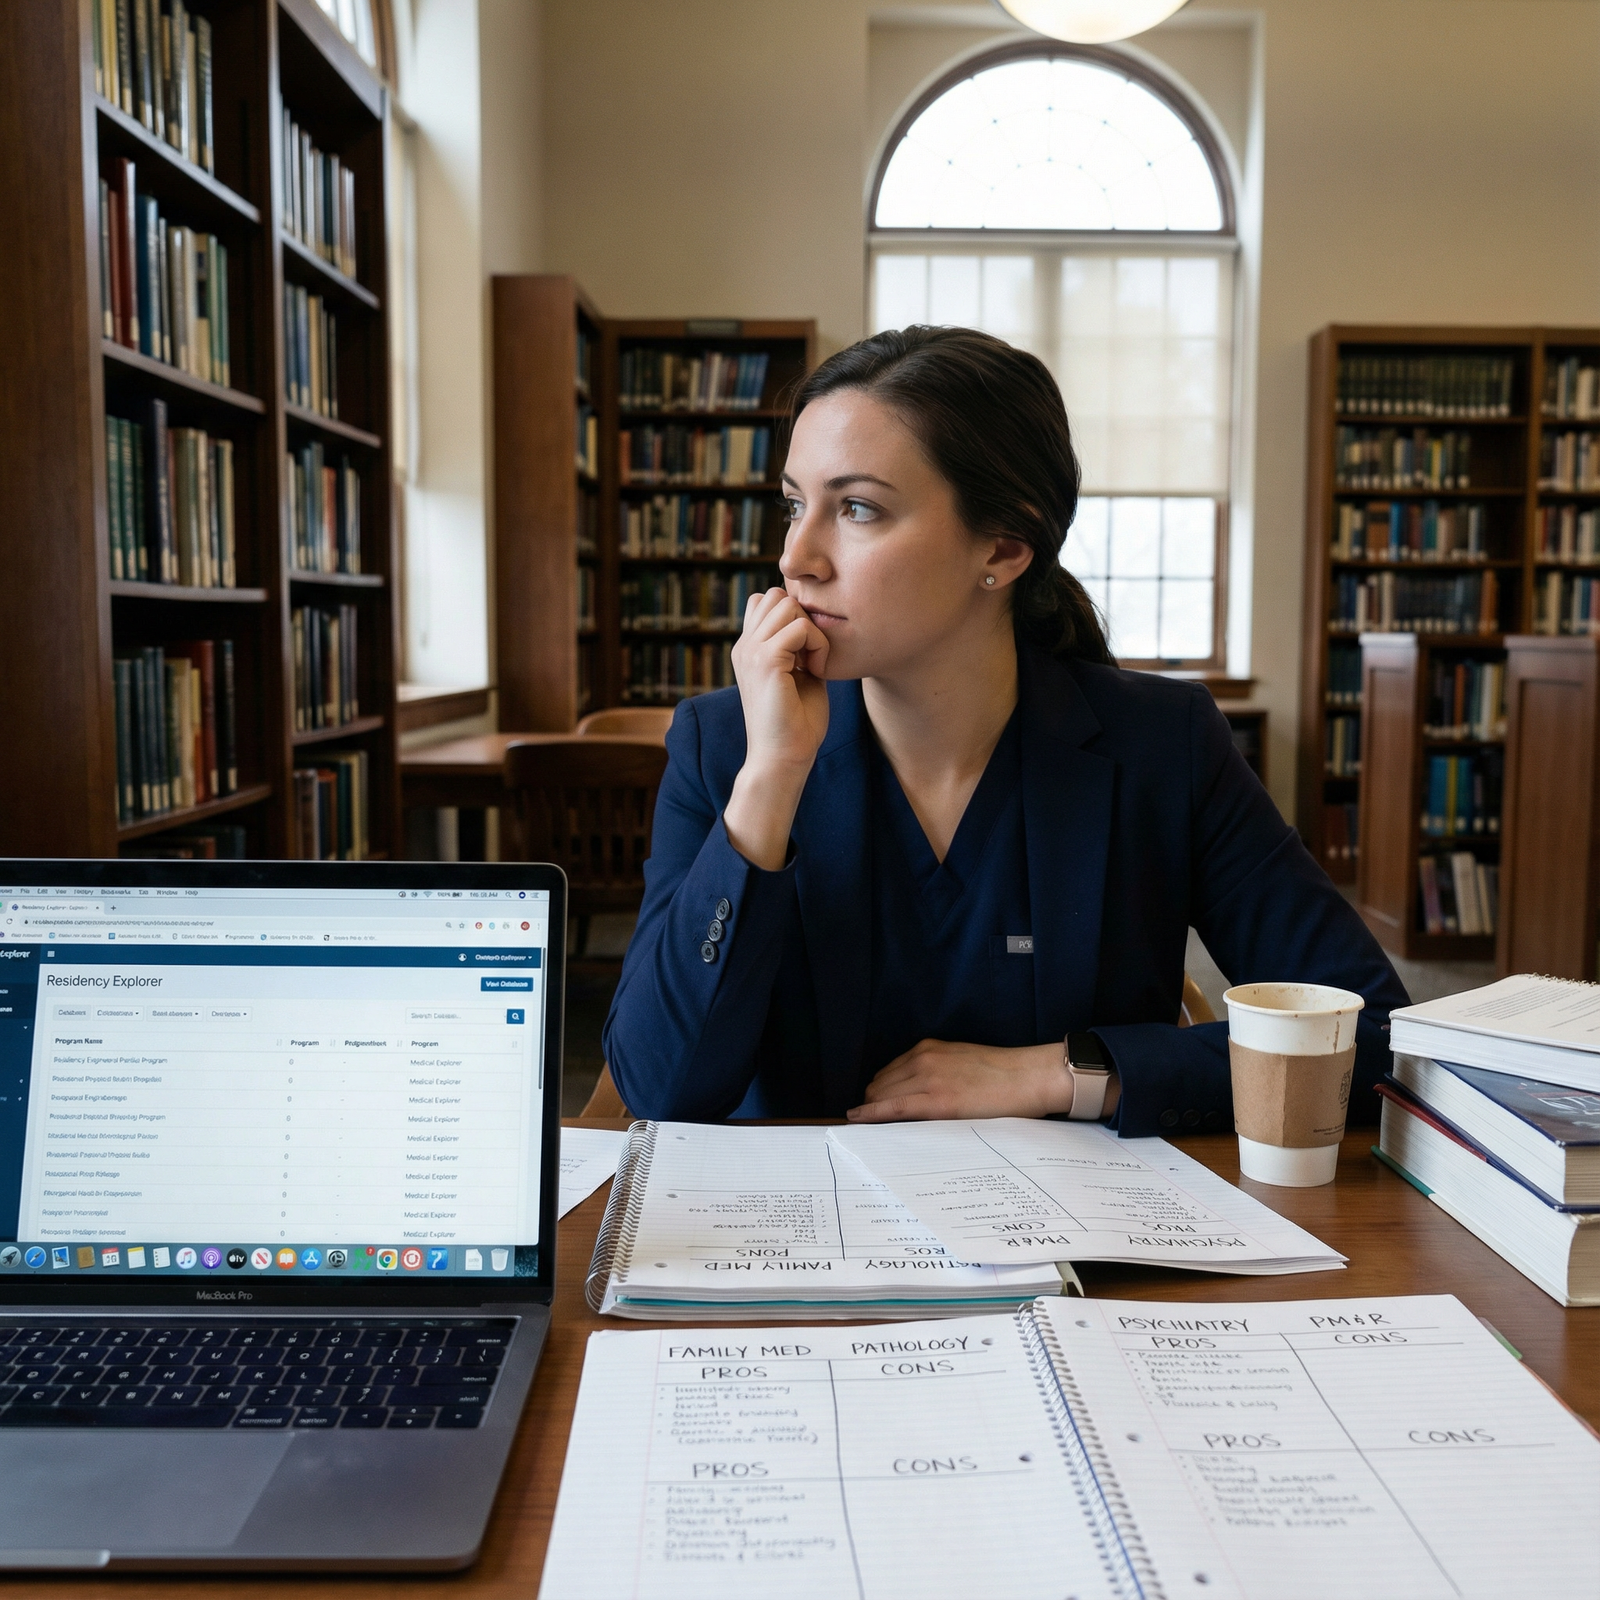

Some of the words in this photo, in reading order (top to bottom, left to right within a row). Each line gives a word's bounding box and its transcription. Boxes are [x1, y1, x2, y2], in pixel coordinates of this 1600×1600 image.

[47, 975, 110, 989] Residency
[113, 975, 163, 989] Explorer
[55, 1037, 83, 1046] Program
[291, 1040, 319, 1048] Program
[992, 1221, 1045, 1232] CONS
[238, 1291, 253, 1300] Pro
[1118, 1316, 1250, 1333] PSYCHIATRY
[1309, 1311, 1392, 1329] PM&R
[669, 1345, 748, 1359] FAMILY
[761, 1345, 812, 1357] MED
[851, 1335, 968, 1354] PATHOLOGY
[1151, 1336, 1216, 1349] PROS
[1334, 1331, 1408, 1344] CONS
[702, 1366, 768, 1379] PROS
[881, 1359, 954, 1376] CONS
[172, 1391, 184, 1399] N
[218, 1391, 231, 1399] M
[1204, 1432, 1282, 1448] PROS
[1408, 1428, 1496, 1444] CONS
[693, 1462, 769, 1478] PROS
[893, 1455, 978, 1474] CONS
